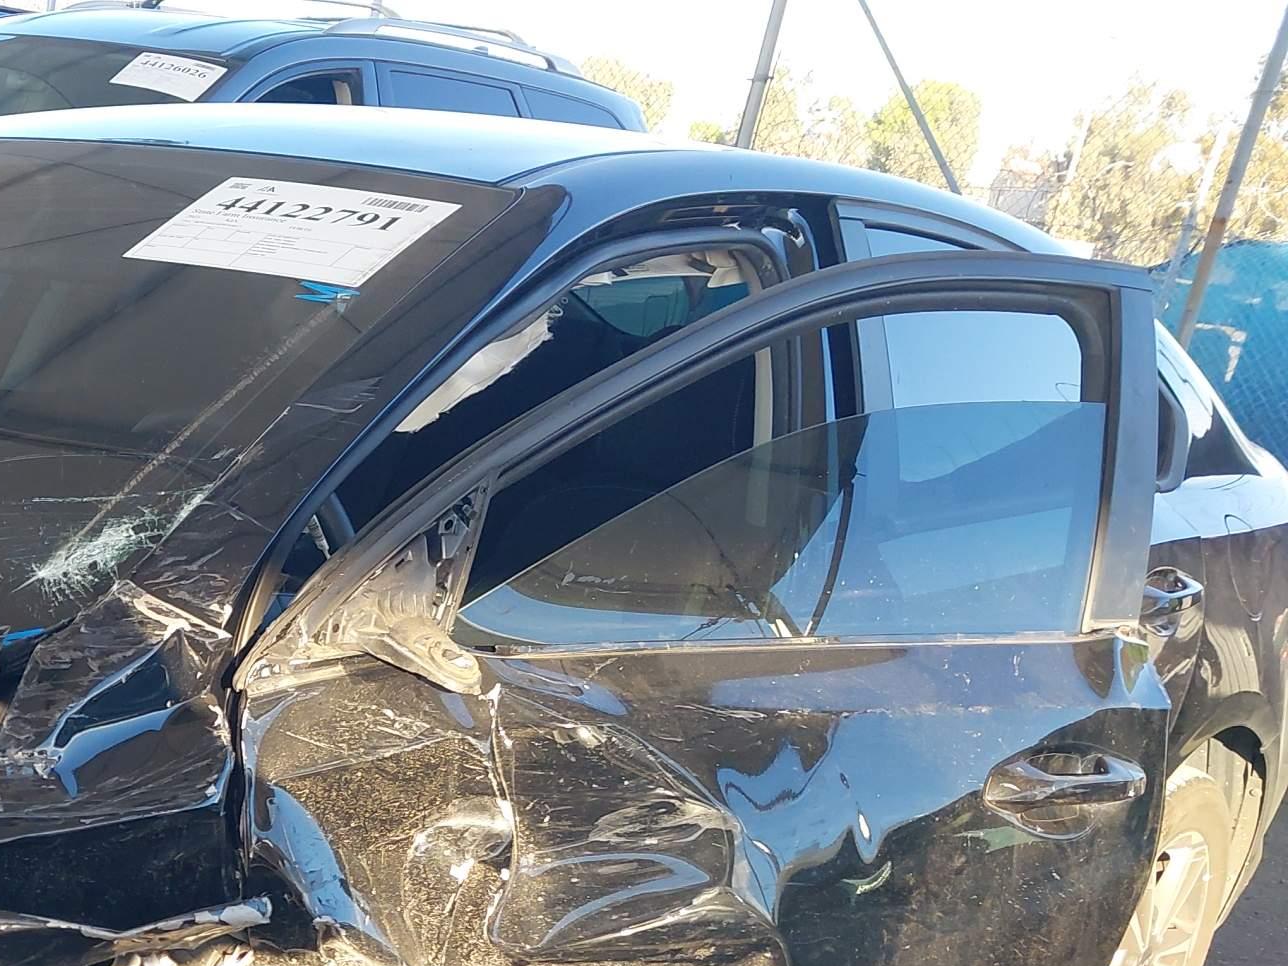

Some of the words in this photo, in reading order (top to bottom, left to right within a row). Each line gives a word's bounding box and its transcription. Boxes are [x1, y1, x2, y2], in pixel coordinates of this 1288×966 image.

[140, 60, 207, 79] 44126026
[216, 196, 402, 231] 44122791
[216, 211, 241, 219] Farm
[242, 213, 287, 223] Insurance
